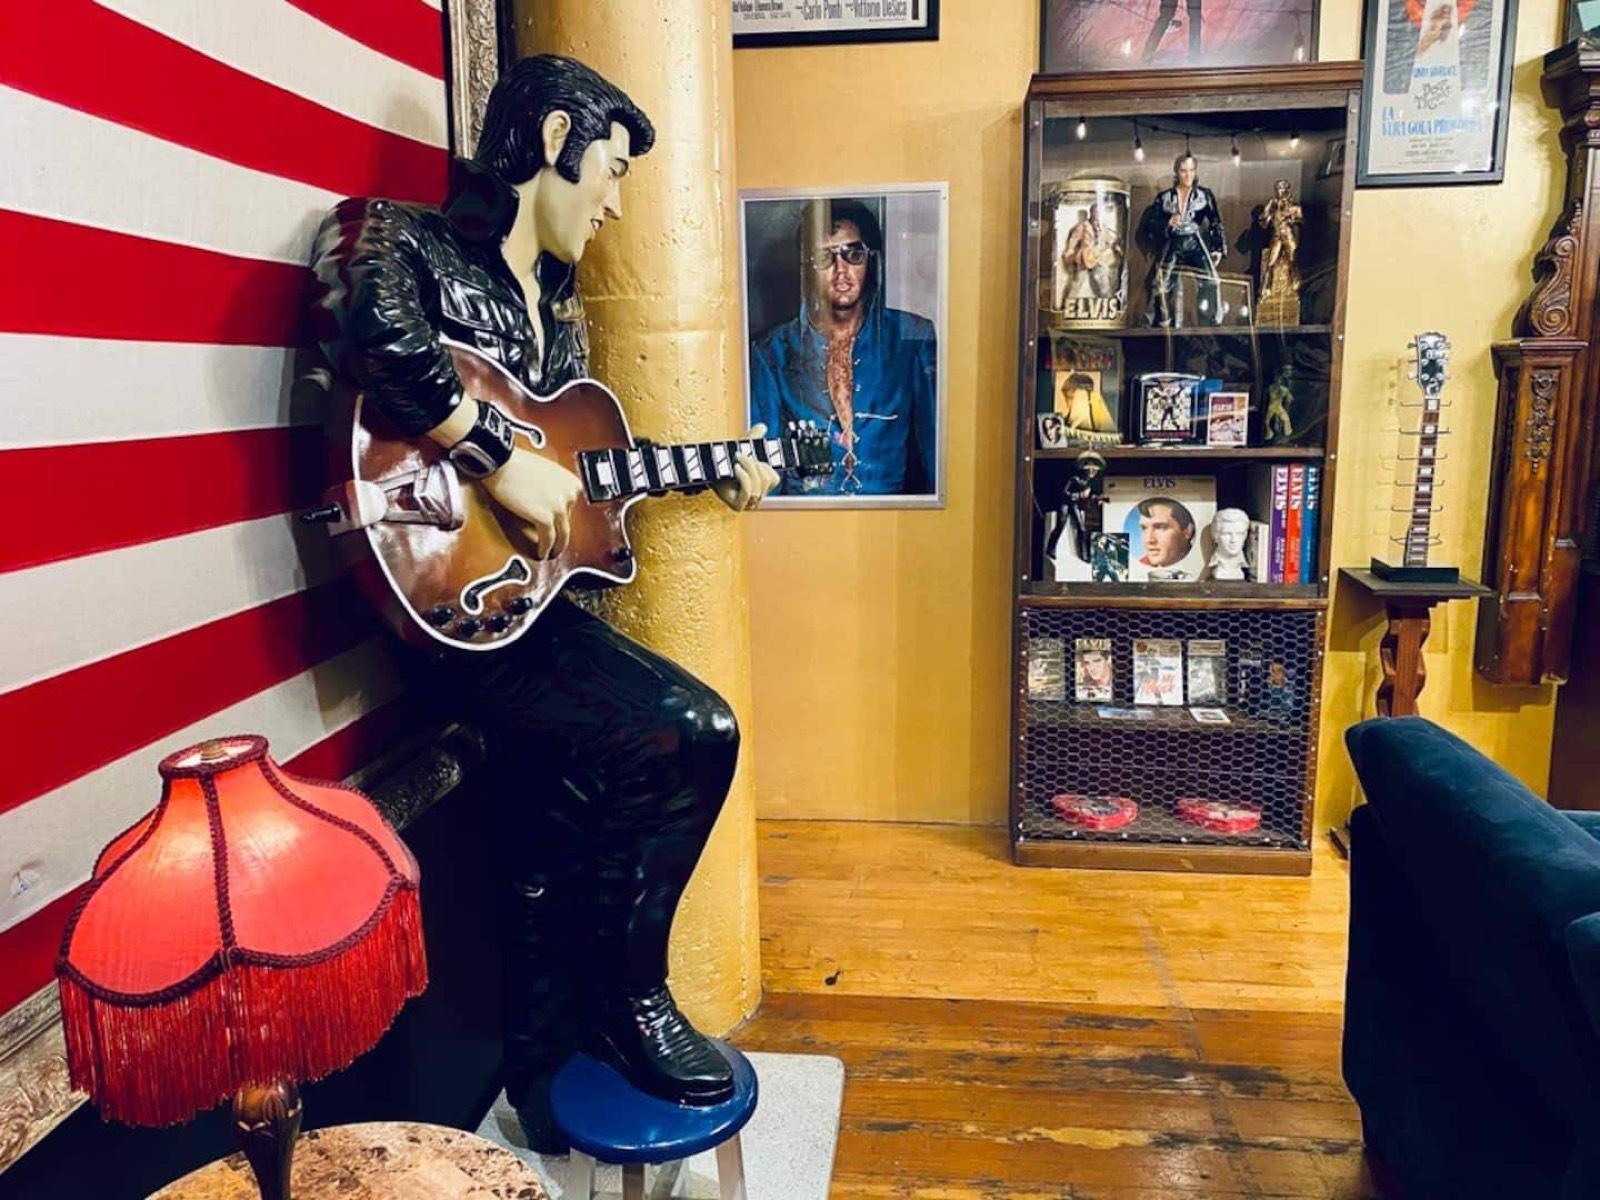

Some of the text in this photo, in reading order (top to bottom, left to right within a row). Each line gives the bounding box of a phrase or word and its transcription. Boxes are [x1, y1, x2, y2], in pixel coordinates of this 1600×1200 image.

[1064, 298, 1117, 319] ELVIS
[1143, 478, 1176, 489] ELVIS
[1275, 467, 1289, 511] ELVIS
[1290, 467, 1303, 510] ELVIS
[1306, 467, 1318, 511] ELVIS
